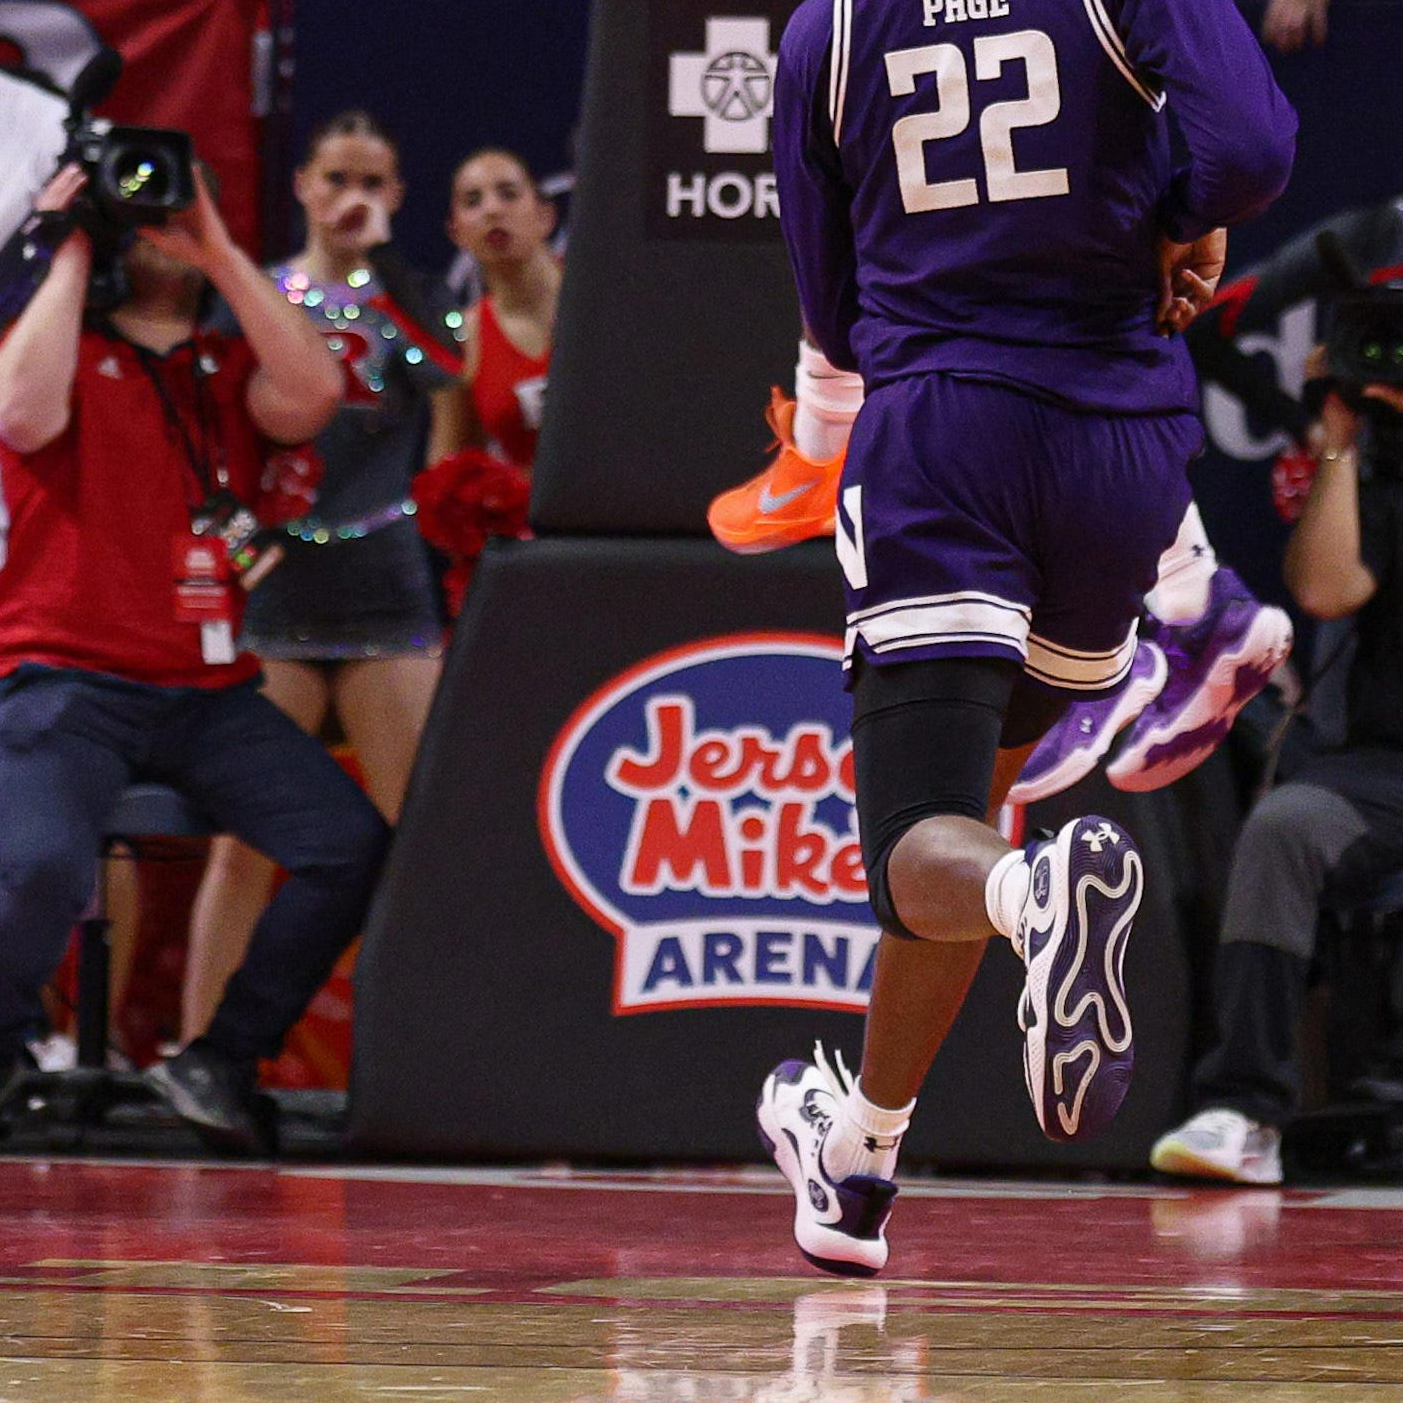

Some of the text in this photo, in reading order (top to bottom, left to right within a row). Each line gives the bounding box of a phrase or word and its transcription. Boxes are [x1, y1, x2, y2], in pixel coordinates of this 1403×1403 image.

[884, 29, 1070, 214] 22
[667, 172, 780, 219] HOR
[615, 704, 855, 792] Jers
[629, 799, 869, 896] Mike
